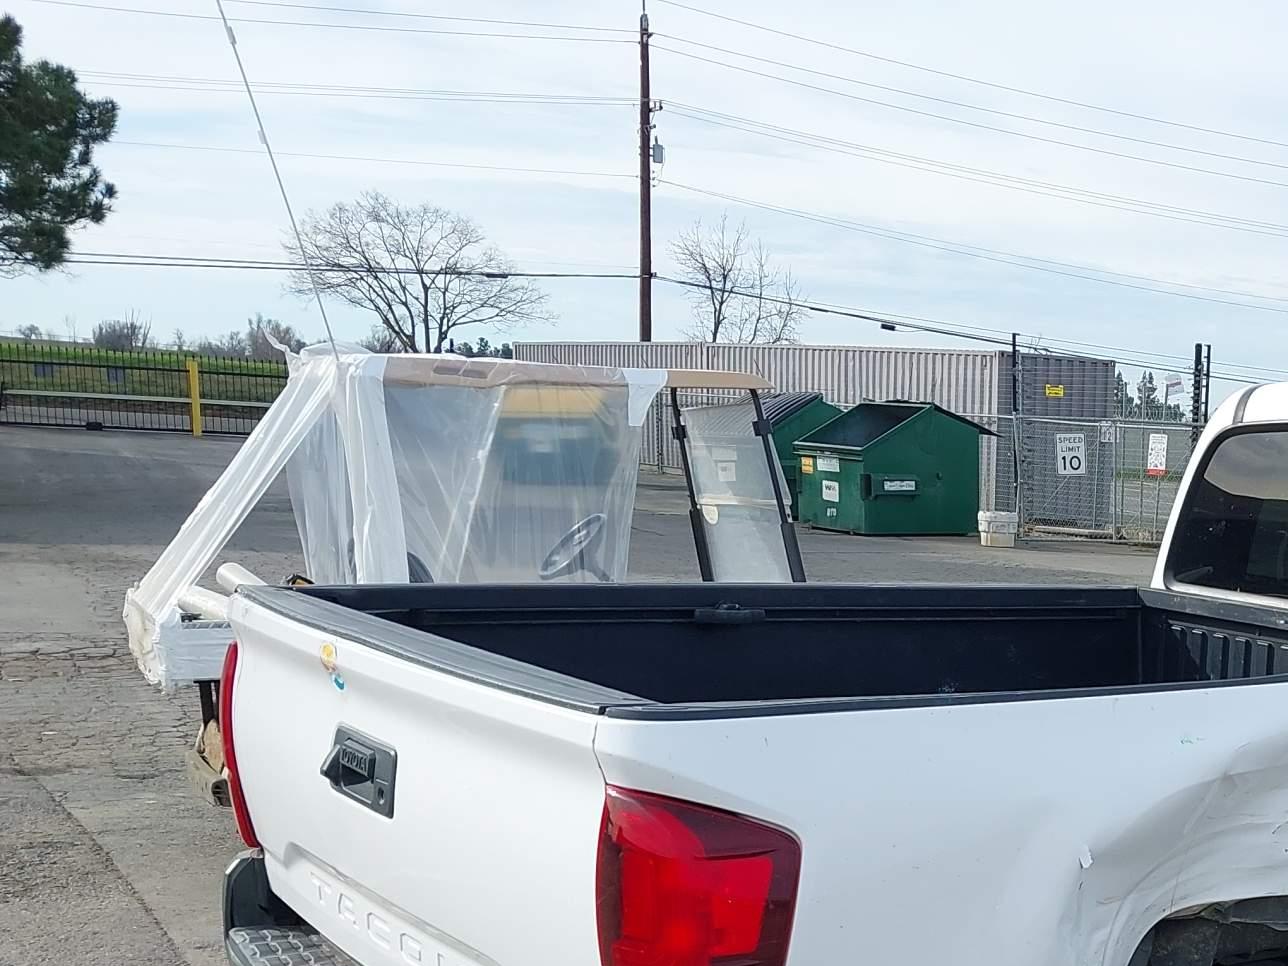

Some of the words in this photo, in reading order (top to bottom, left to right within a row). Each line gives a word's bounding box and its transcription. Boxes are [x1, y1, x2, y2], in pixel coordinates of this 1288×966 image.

[1058, 436, 1083, 444] SPEED
[1061, 445, 1080, 453] LIMIT
[1061, 455, 1081, 471] 10
[341, 748, 368, 773] TOYOTA
